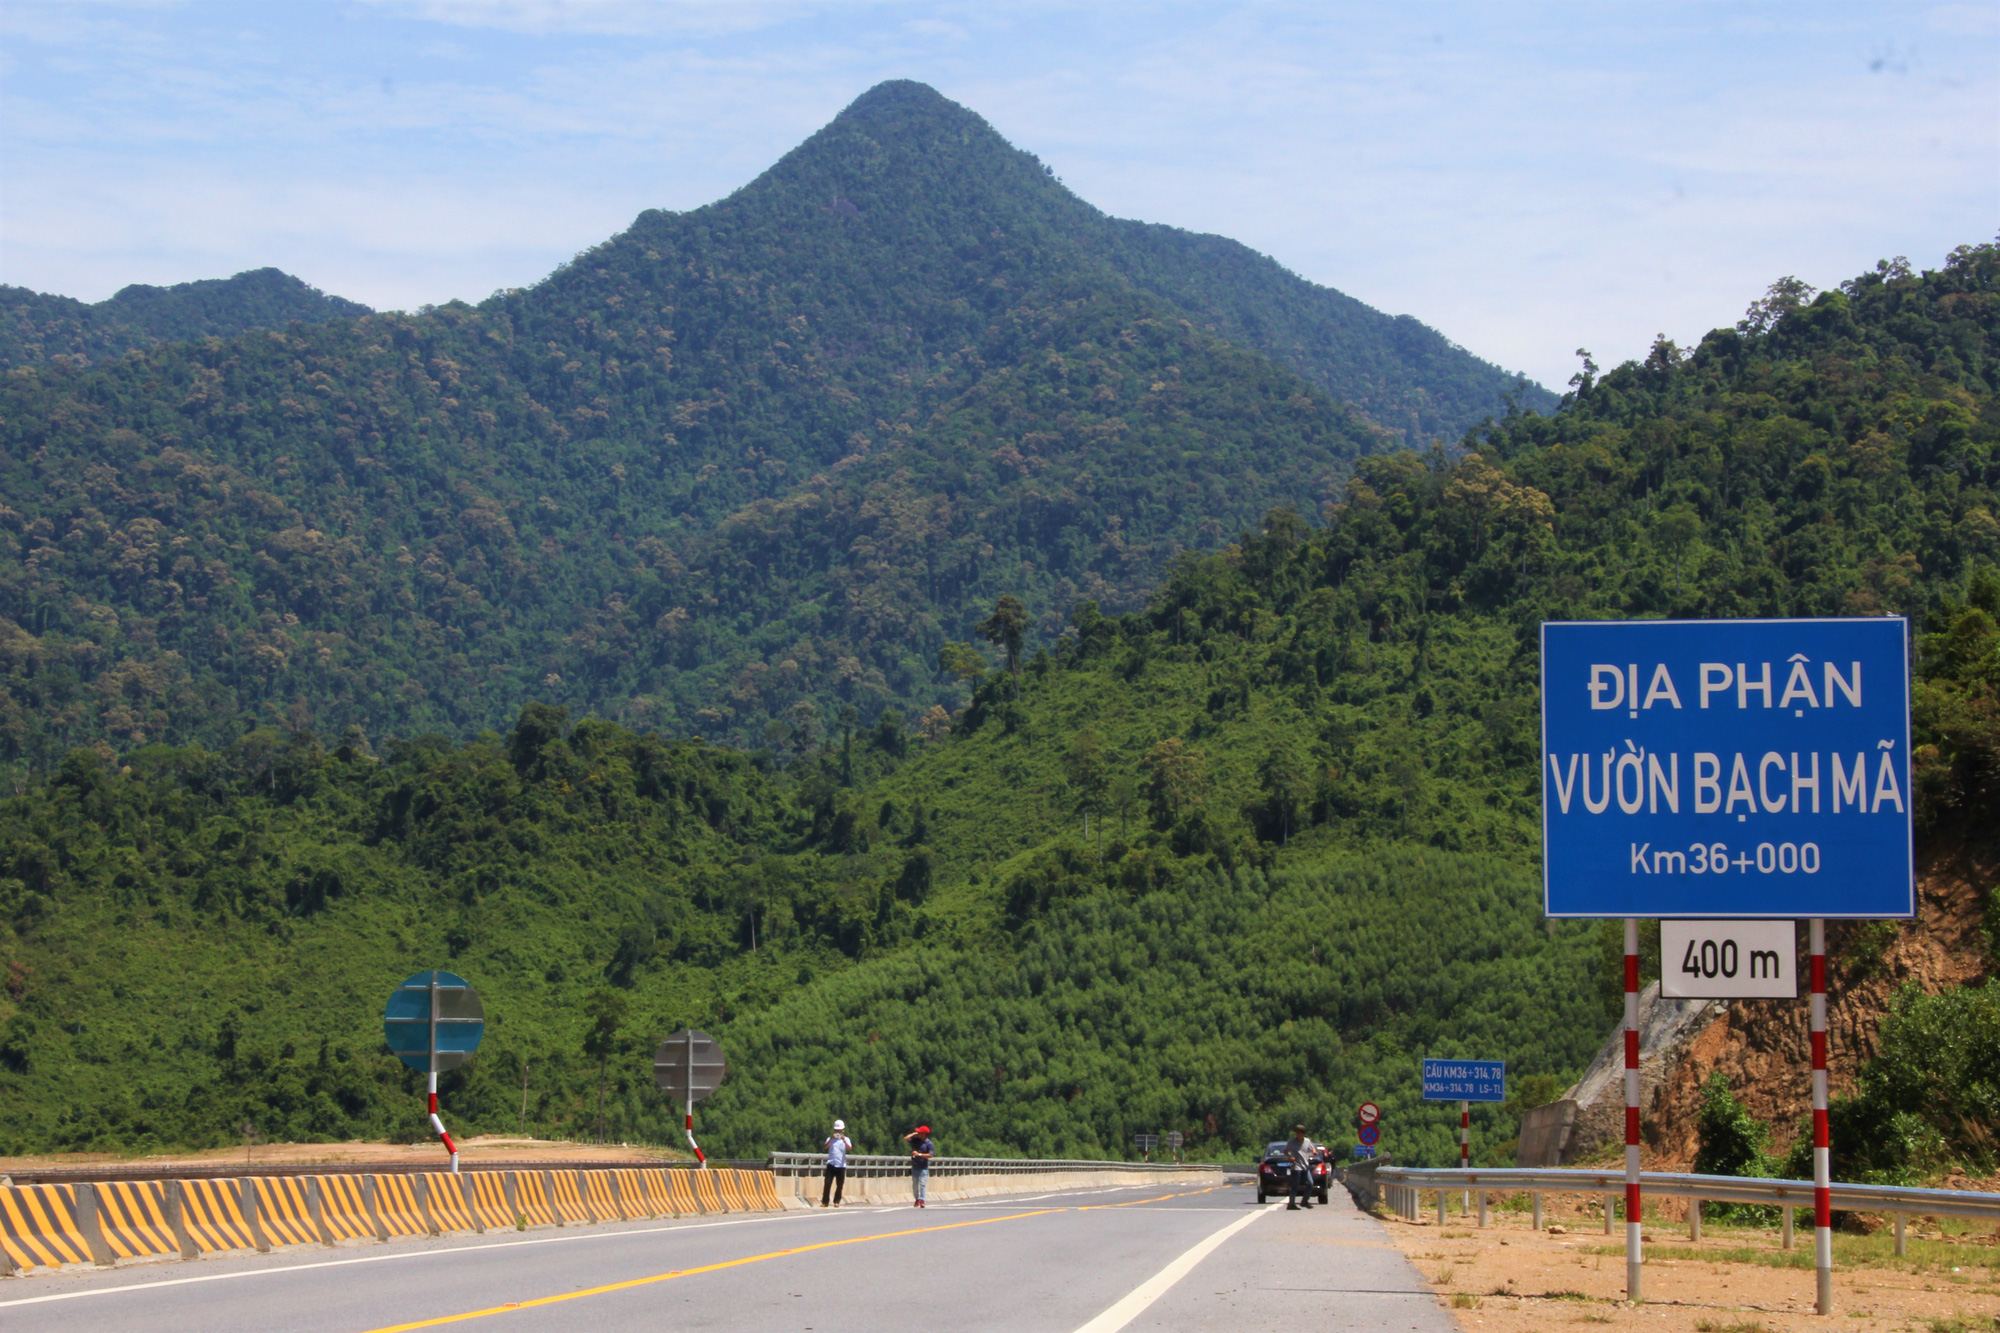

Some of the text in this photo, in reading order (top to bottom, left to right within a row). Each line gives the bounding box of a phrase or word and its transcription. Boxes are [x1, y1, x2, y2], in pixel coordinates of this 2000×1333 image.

[1587, 653, 1862, 719] ĐỊA PHẬN
[1549, 739, 1905, 822] VƯỜN BẠCH MÃ
[1631, 842, 1821, 874] Km36+000
[1681, 938, 1780, 979] 400 m
